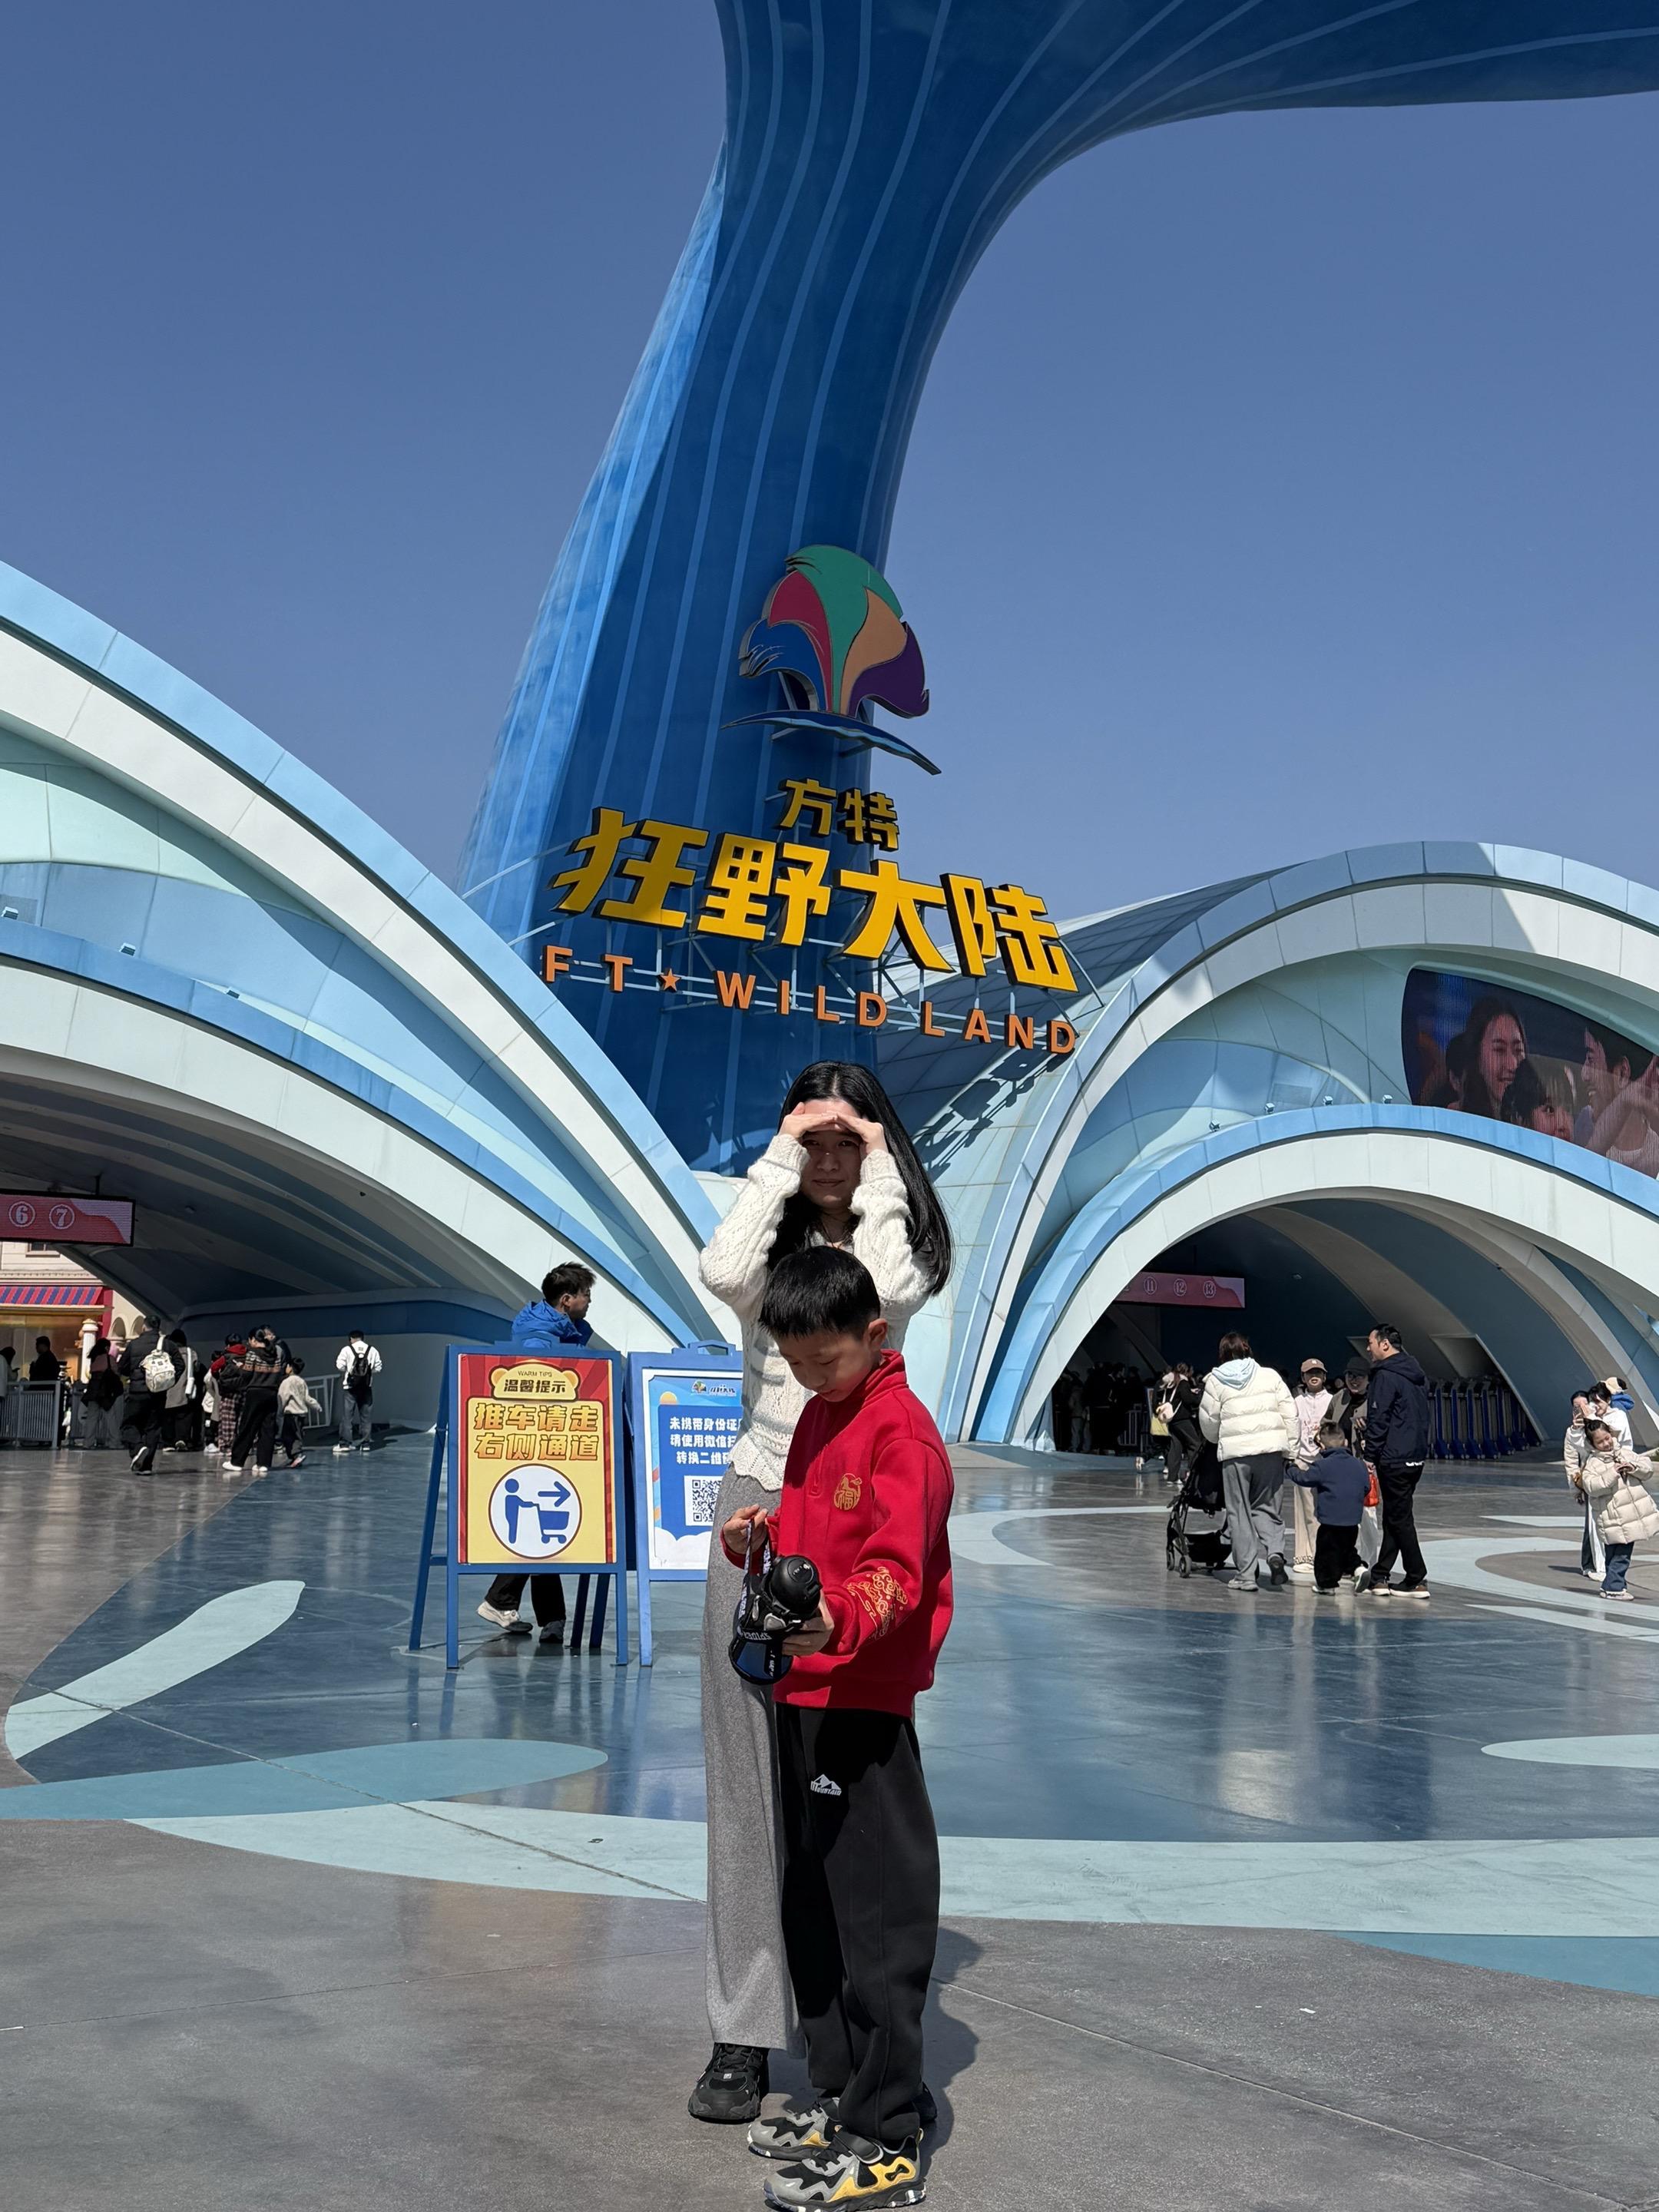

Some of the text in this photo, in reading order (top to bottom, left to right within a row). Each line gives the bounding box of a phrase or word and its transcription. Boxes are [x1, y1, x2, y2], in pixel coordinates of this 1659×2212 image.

[776, 777, 899, 850] 方特
[548, 806, 1078, 992] 狂野大陆
[504, 1379, 566, 1394] 温馨提示
[473, 1402, 598, 1432] 推车请走
[473, 1432, 599, 1461] 右侧通道
